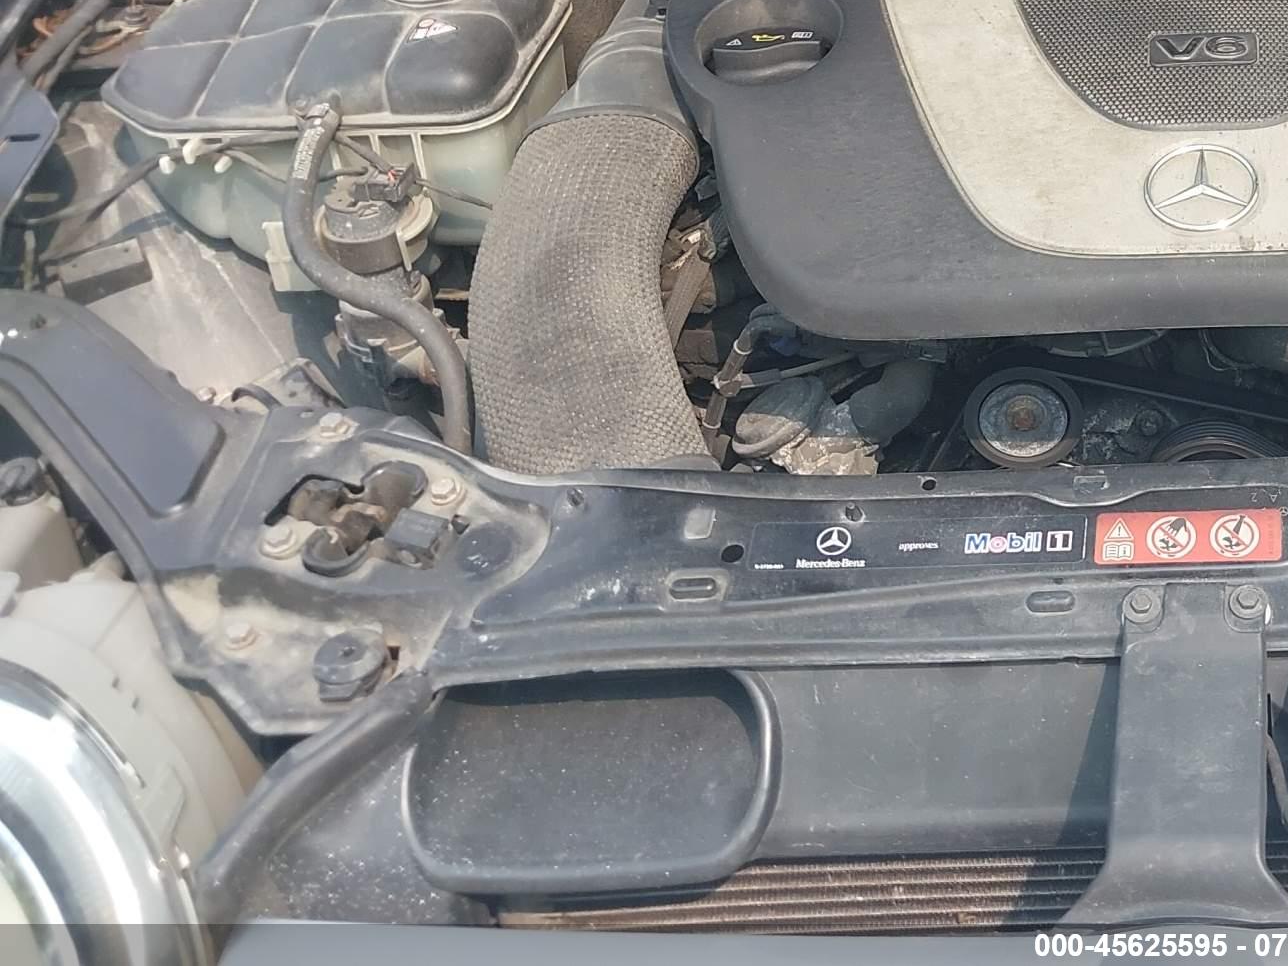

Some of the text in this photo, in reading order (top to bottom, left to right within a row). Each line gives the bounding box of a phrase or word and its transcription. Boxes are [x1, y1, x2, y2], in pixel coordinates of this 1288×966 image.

[1155, 35, 1249, 60] V6
[898, 541, 940, 554] approves
[964, 531, 1043, 555] Mobil
[795, 557, 866, 570] Mercedes-Benz
